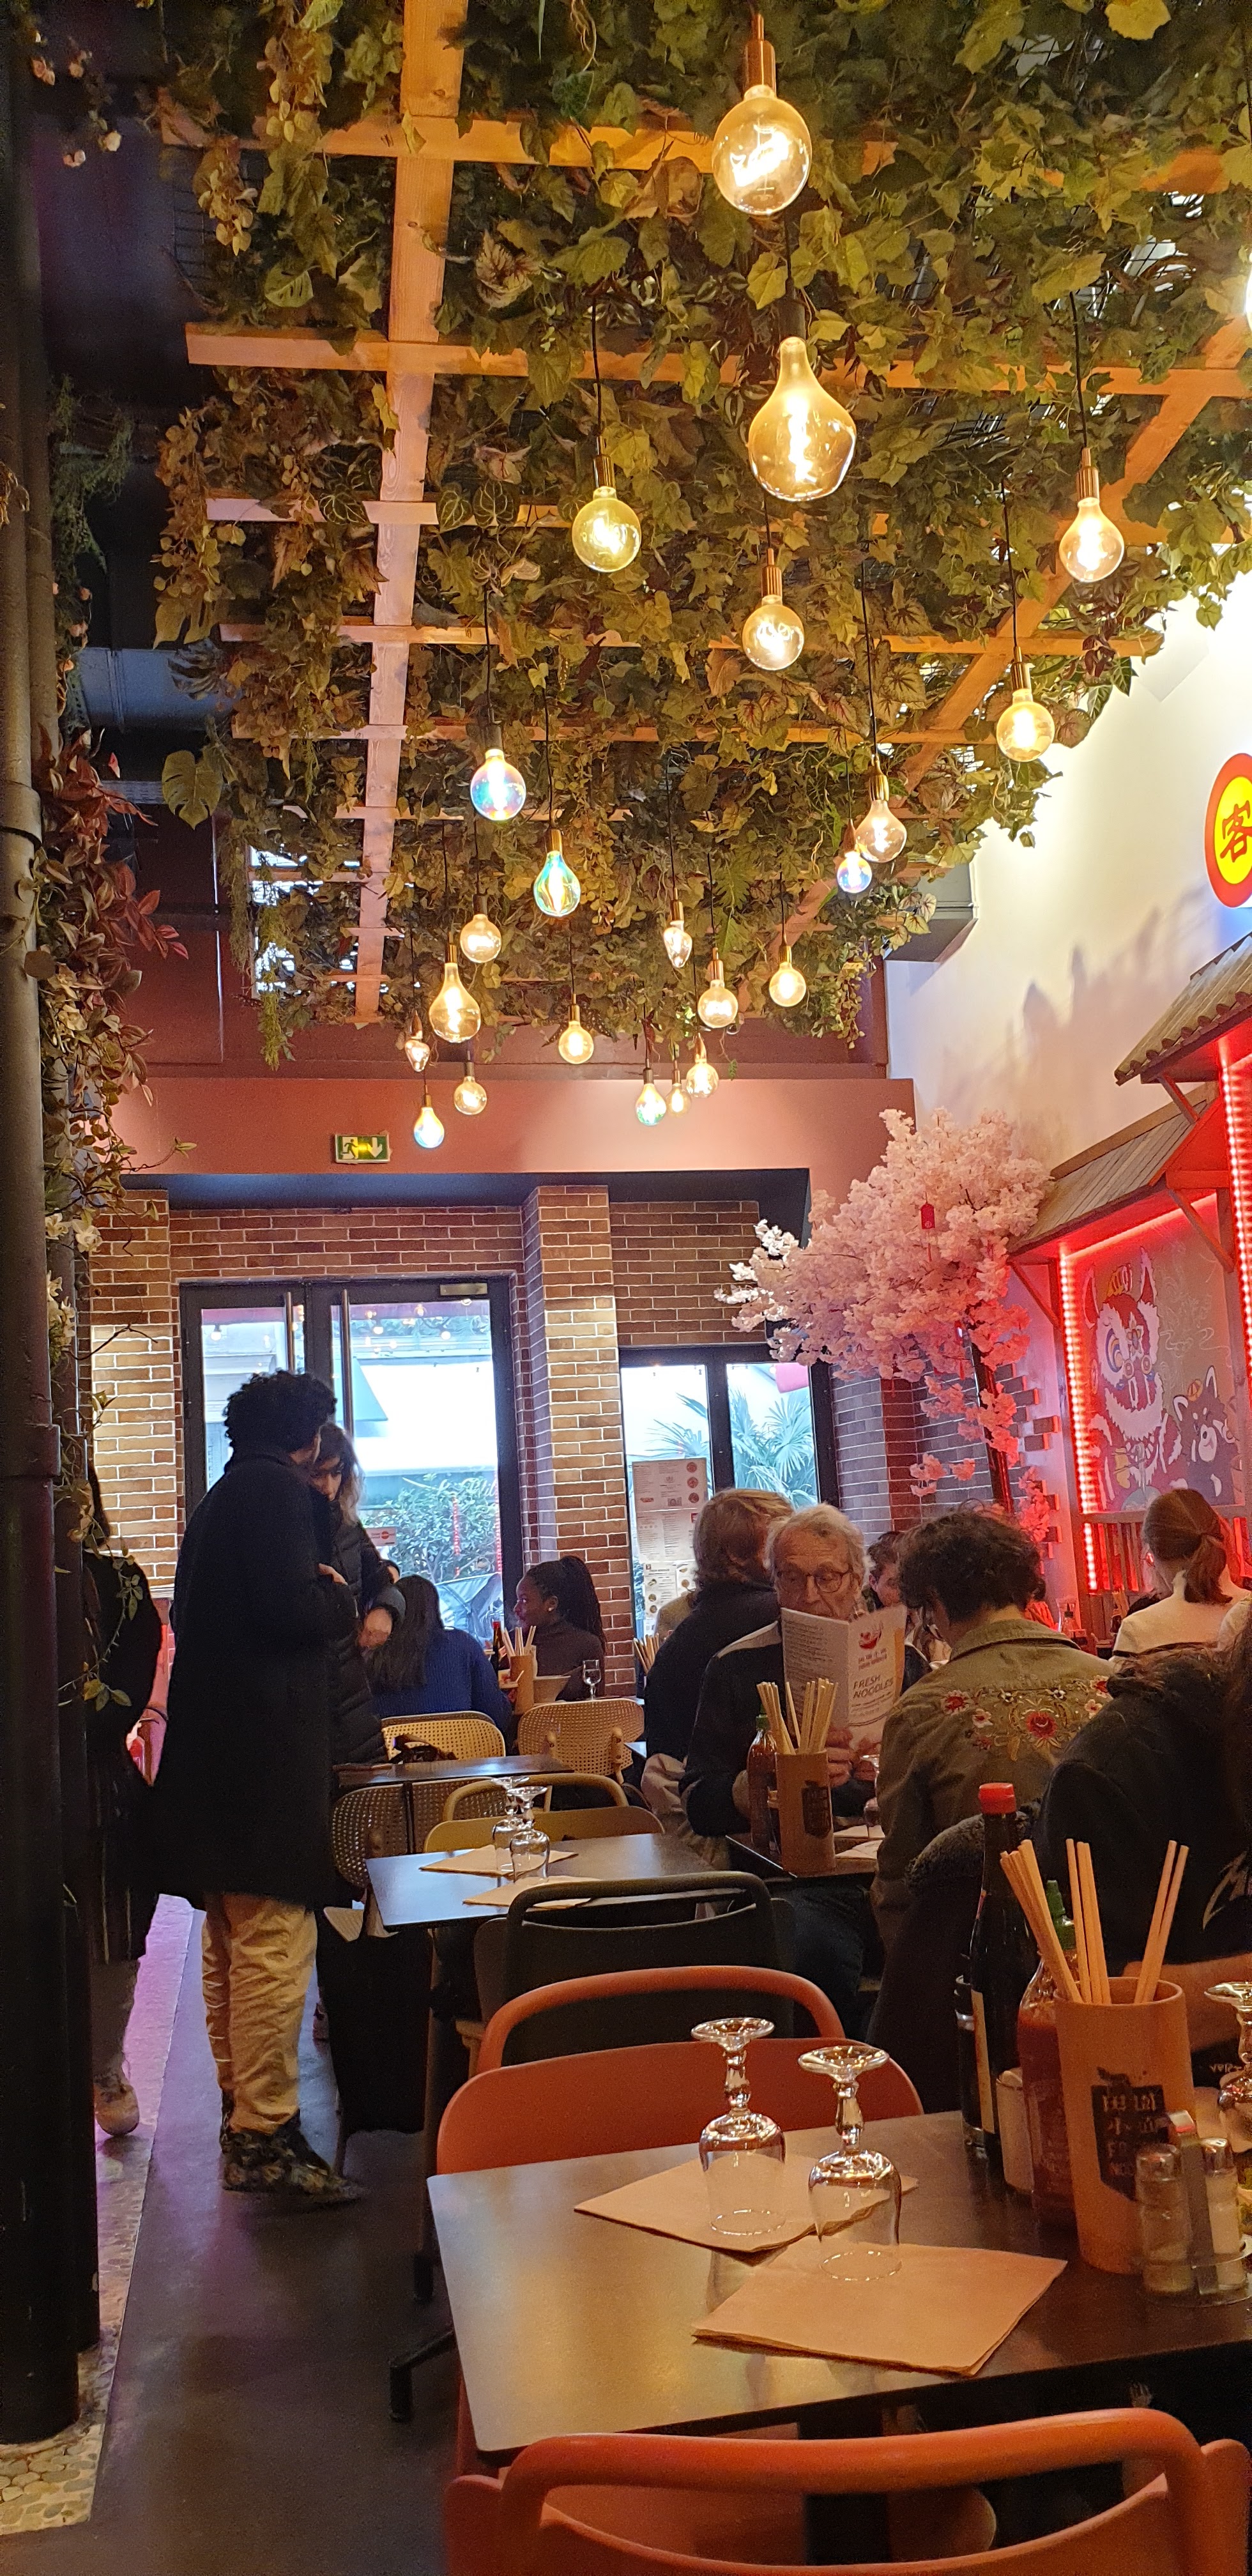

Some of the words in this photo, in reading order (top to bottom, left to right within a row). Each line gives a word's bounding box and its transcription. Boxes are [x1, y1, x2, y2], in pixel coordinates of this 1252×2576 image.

[1220, 800, 1252, 862] 客
[852, 1676, 894, 1699] NOODLES
[853, 1673, 882, 1690] FRESH
